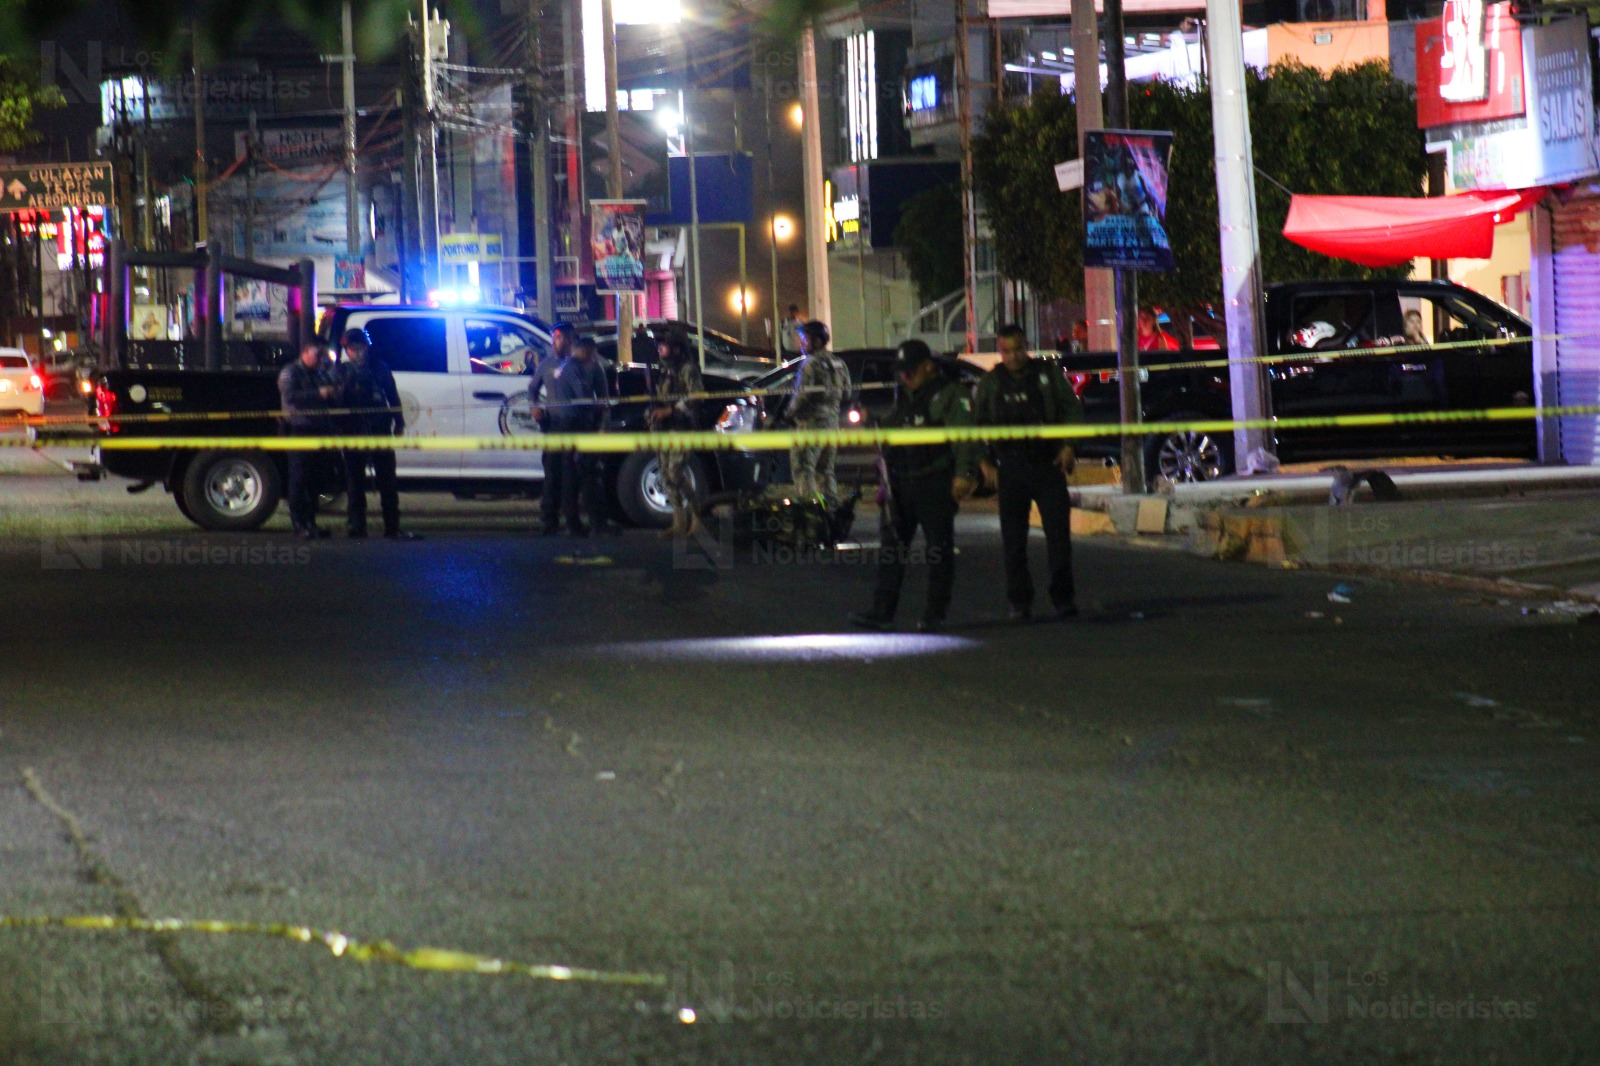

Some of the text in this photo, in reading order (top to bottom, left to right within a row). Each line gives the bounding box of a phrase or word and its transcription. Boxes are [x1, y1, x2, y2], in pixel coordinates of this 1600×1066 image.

[1541, 88, 1585, 143] SALAS
[280, 132, 325, 143] HOTEL
[44, 179, 91, 195] TEPIC
[28, 191, 106, 207] AEROPUERTO
